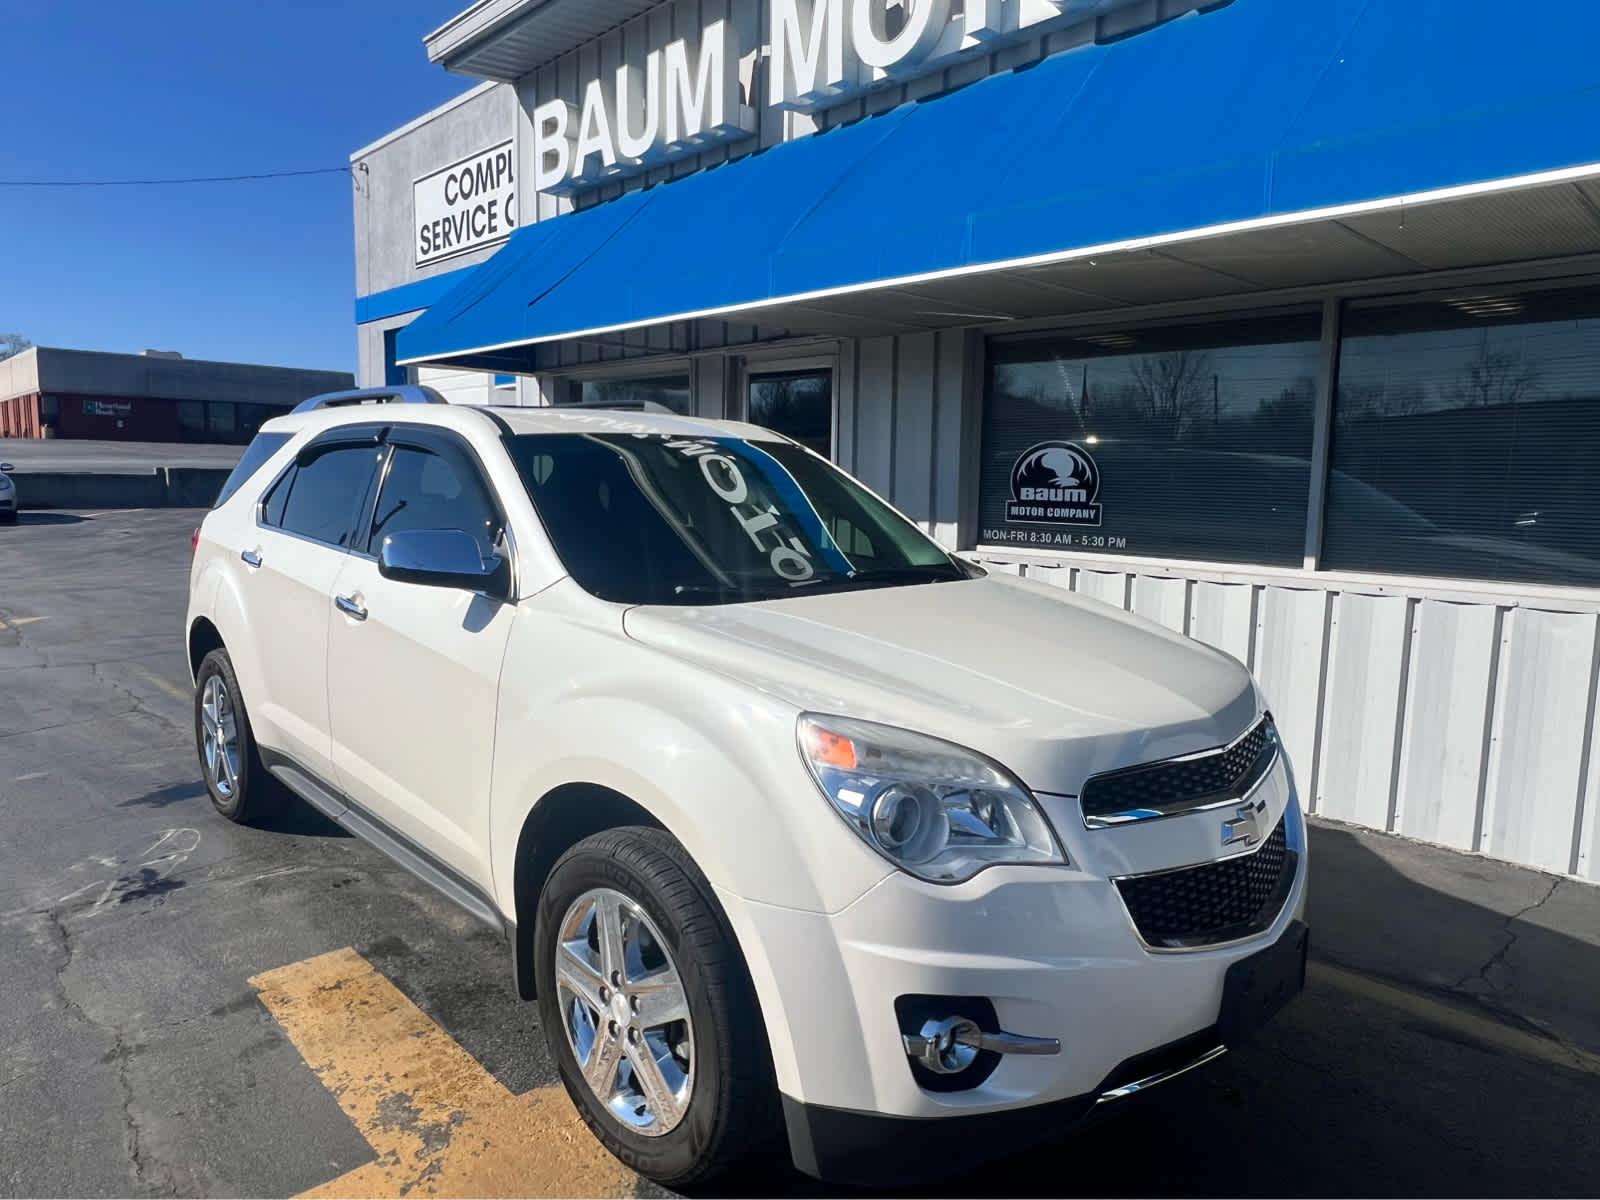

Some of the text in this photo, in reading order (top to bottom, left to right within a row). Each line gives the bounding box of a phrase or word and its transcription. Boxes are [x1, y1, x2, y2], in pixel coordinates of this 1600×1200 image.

[533, 18, 724, 191] BAUM
[420, 199, 498, 255] SERVICE
[1010, 506, 1096, 519] MOTOR COMPANY
[983, 529, 1028, 542] MON-FRI
[1030, 532, 1051, 543] 8:30
[1054, 534, 1072, 545] AM
[1081, 535, 1105, 546] 5:30
[1108, 537, 1126, 548] PM
